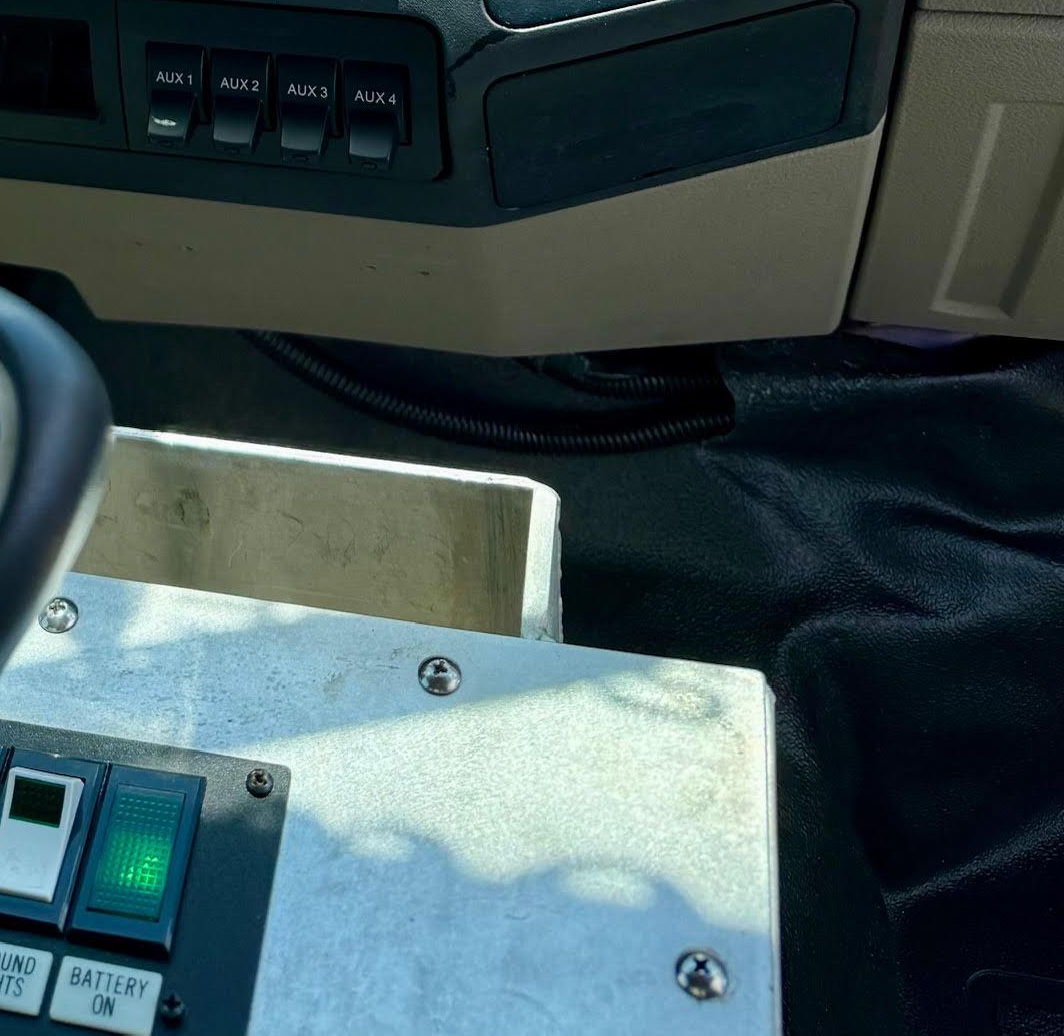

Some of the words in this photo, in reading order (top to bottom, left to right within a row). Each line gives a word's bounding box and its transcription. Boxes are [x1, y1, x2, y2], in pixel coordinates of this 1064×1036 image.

[156, 71, 184, 84] AUX
[187, 74, 193, 85] 1
[220, 77, 249, 91] AUX
[251, 80, 259, 92] 2
[287, 83, 317, 98] AUX
[320, 86, 328, 99] 3
[354, 90, 385, 104] AUX
[388, 93, 396, 105] 4
[70, 967, 149, 999] BATTERY
[92, 994, 115, 1017] ON
